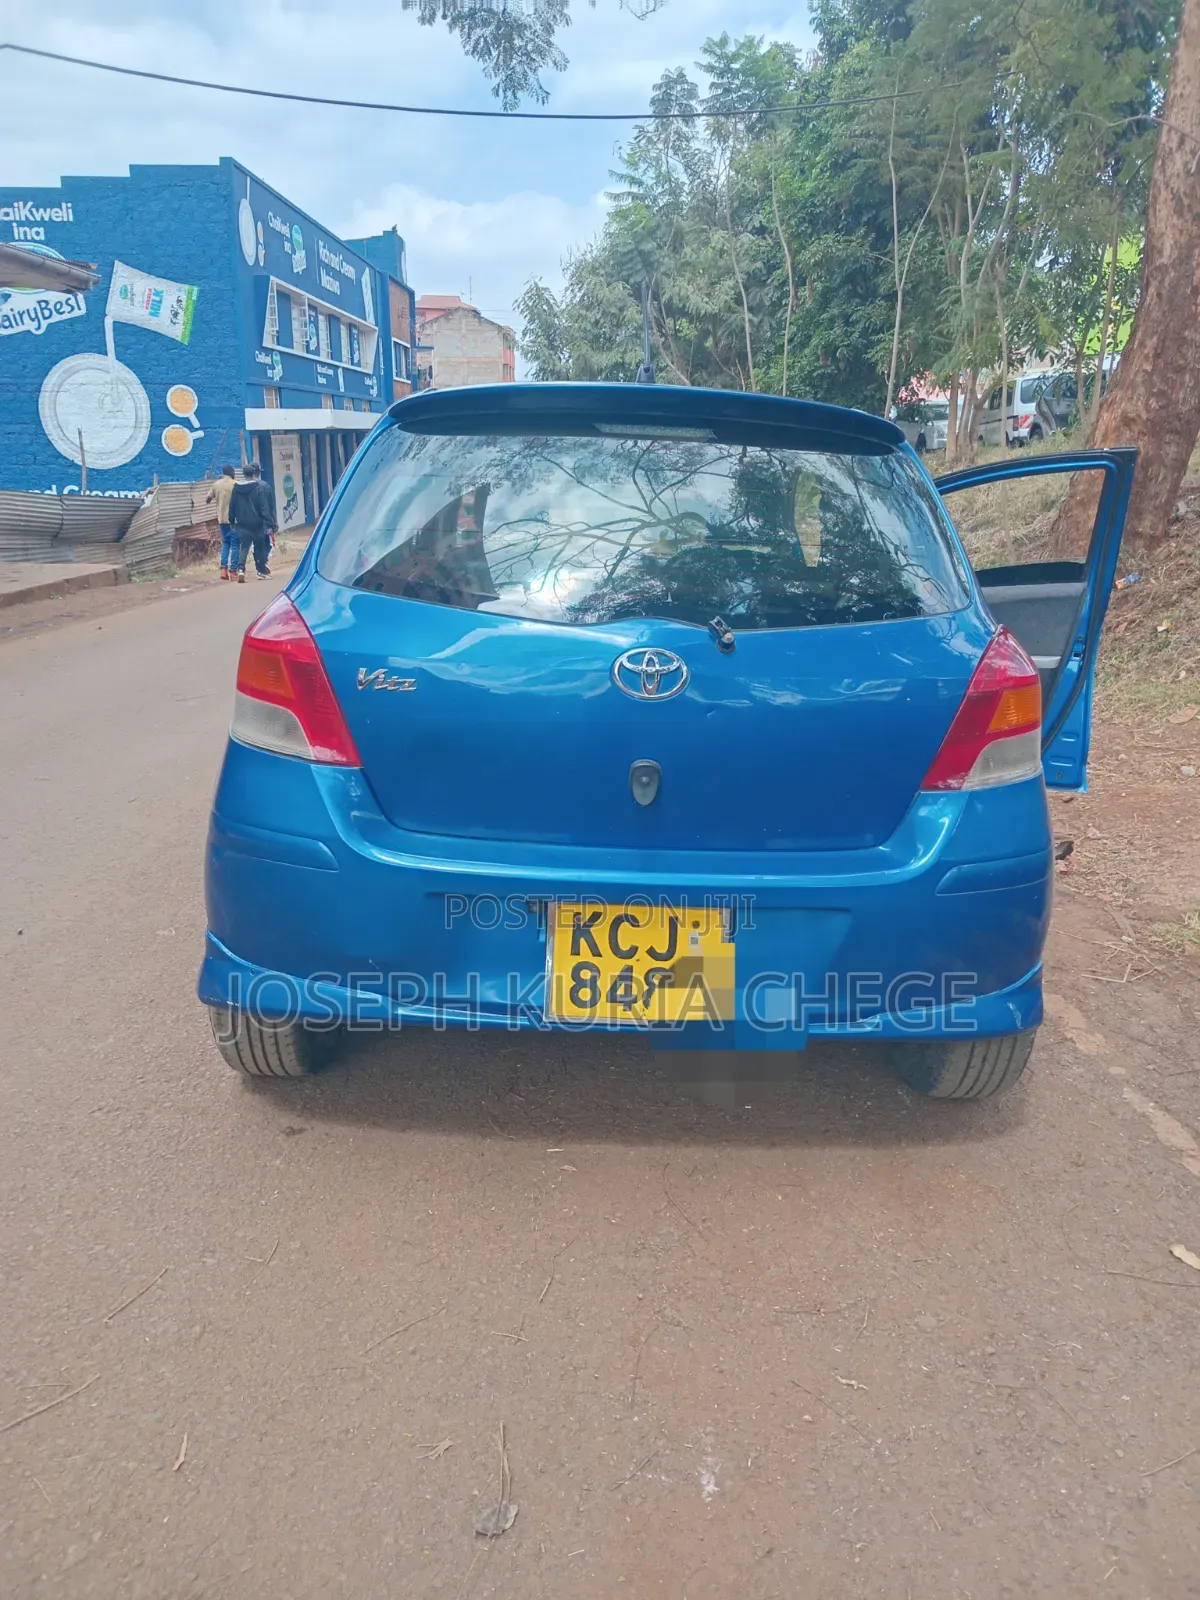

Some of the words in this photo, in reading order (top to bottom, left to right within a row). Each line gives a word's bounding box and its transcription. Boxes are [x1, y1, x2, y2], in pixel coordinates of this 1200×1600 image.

[0, 201, 73, 222] aiKweli
[12, 222, 45, 240] ina
[0, 292, 82, 331] airyBest
[357, 668, 416, 691] Vitz
[570, 911, 679, 961] KCJ
